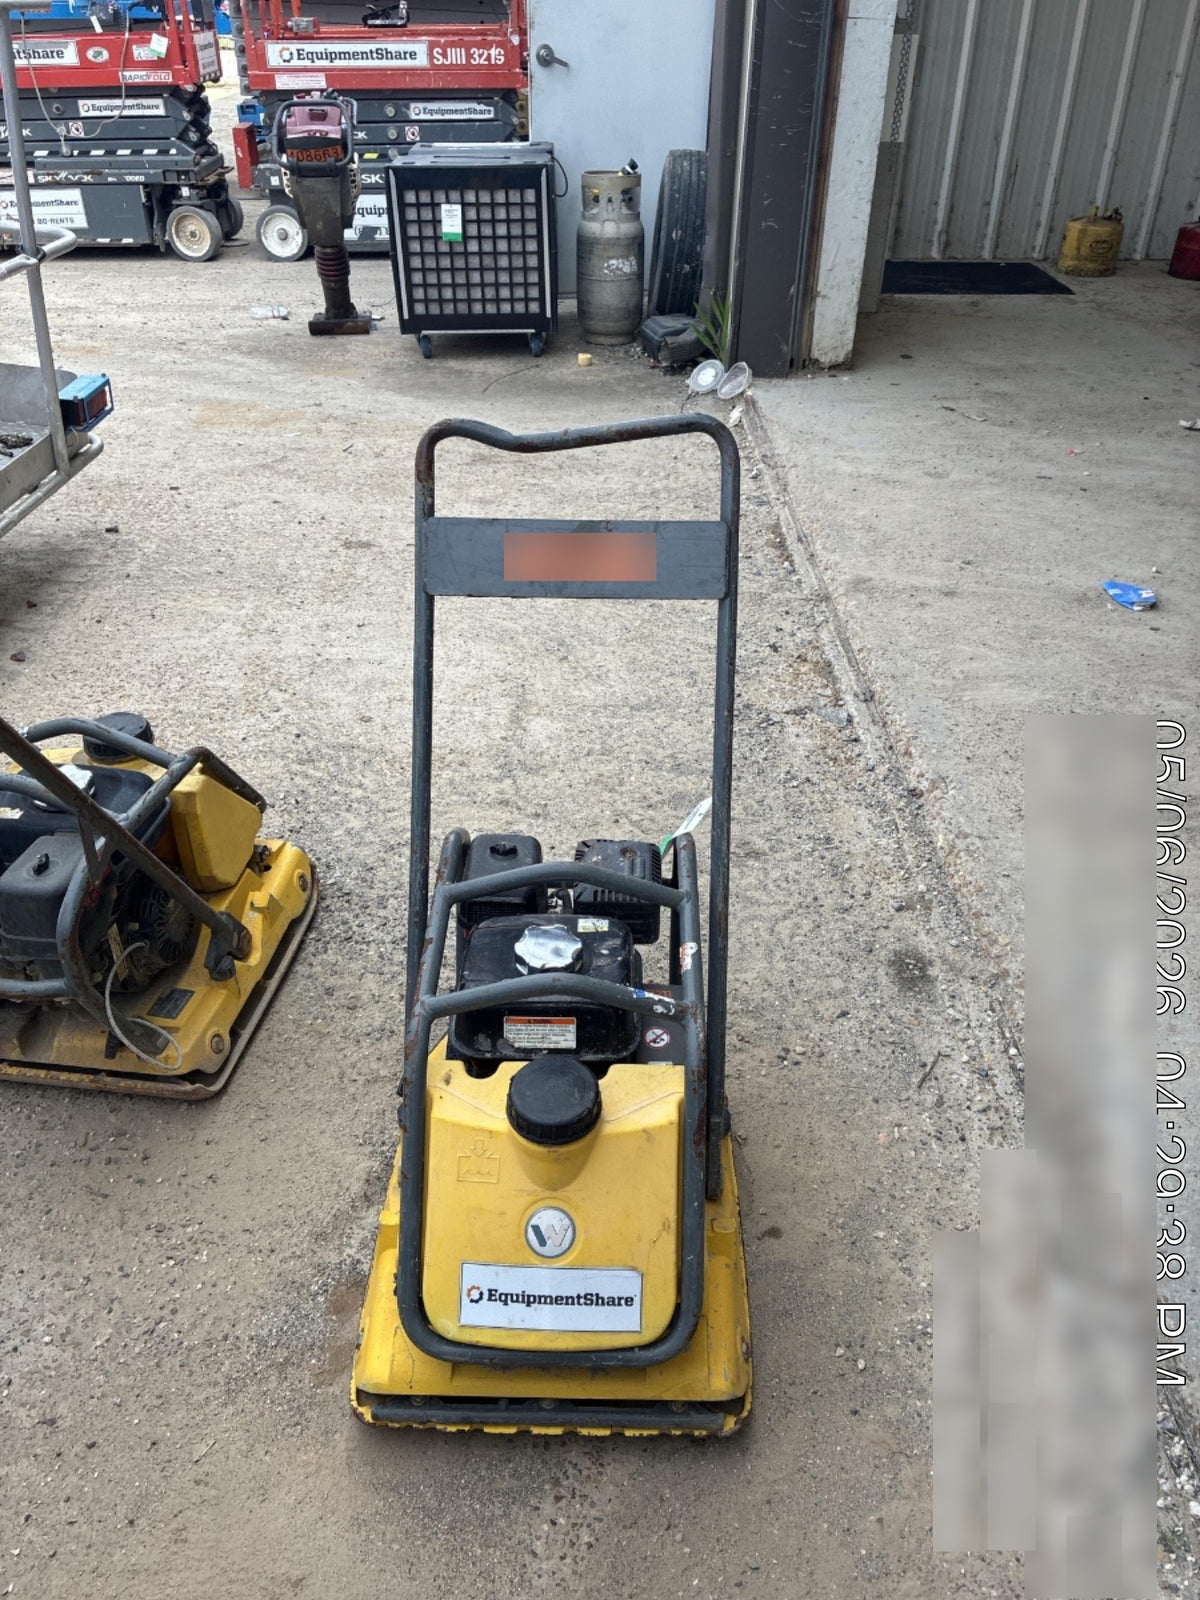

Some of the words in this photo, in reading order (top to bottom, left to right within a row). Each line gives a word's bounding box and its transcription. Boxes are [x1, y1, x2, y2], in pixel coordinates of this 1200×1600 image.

[296, 47, 417, 63] EquipmentShare
[432, 47, 466, 65] SJIII
[91, 102, 160, 112] EquipmentShare
[422, 106, 492, 117] EquipmentShare
[486, 1288, 635, 1308] EquipmentShare
